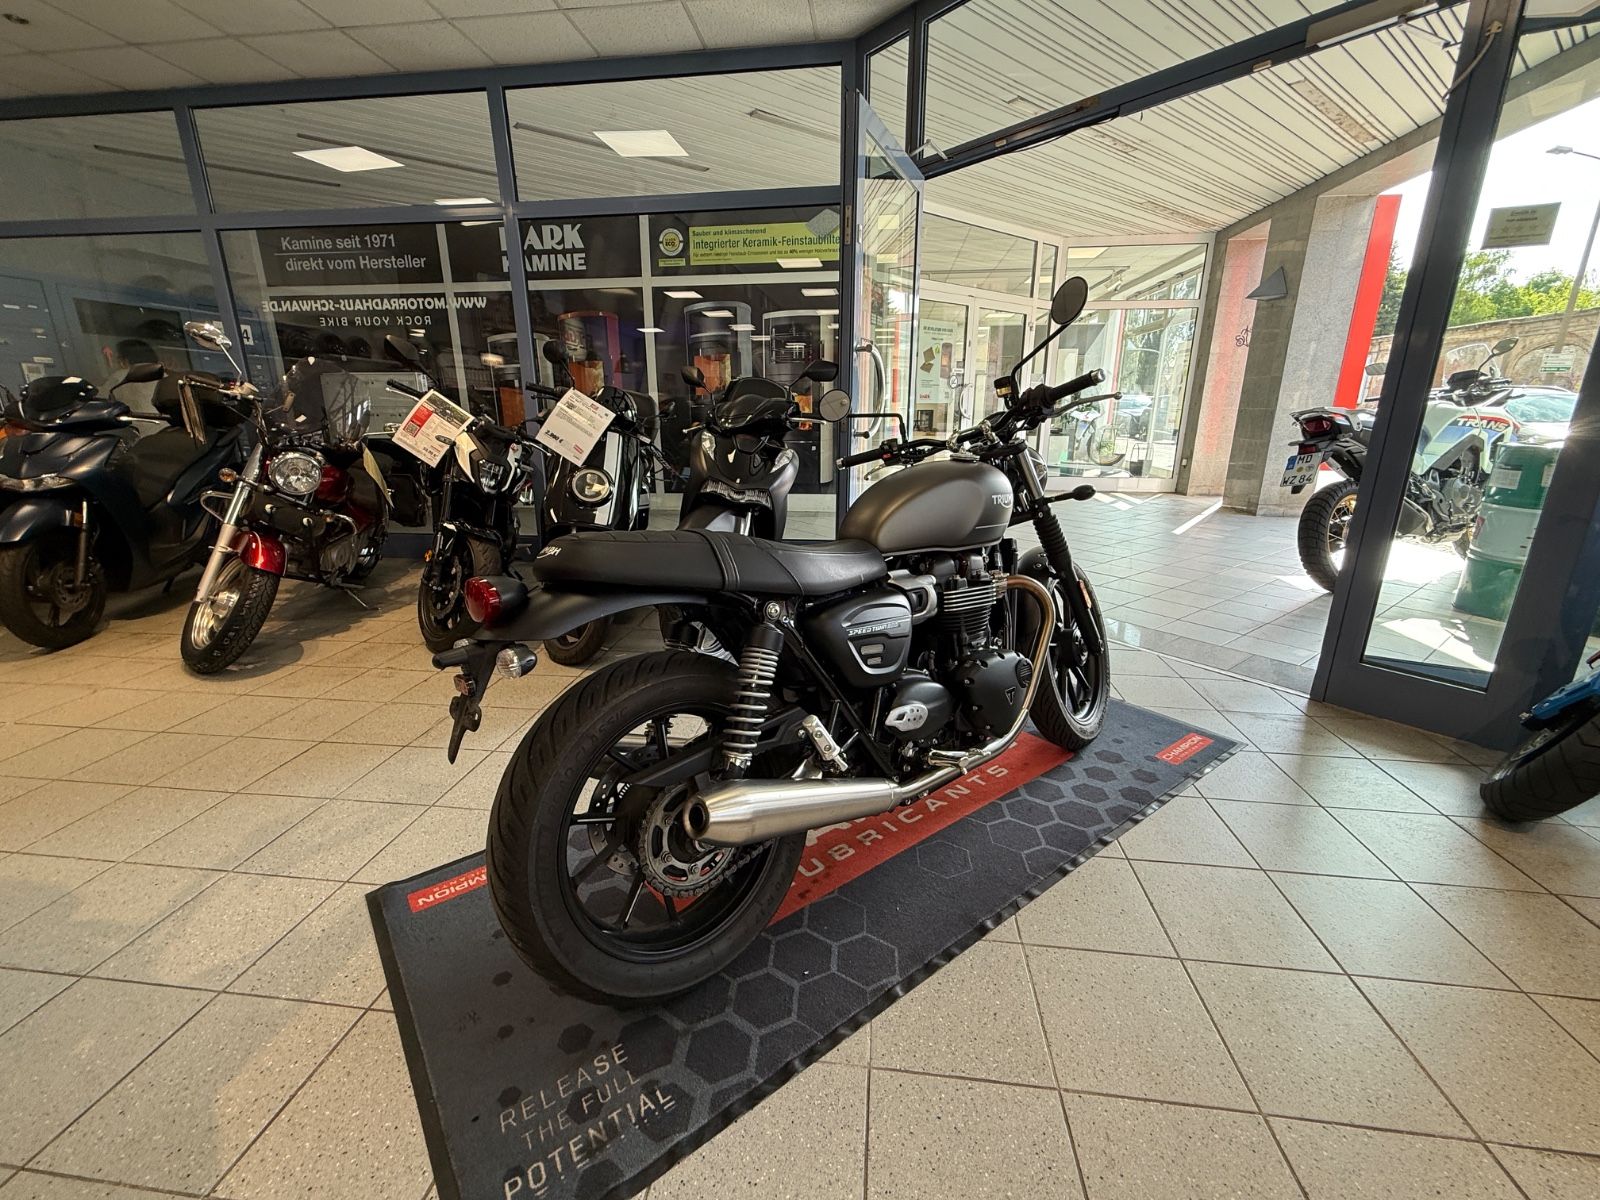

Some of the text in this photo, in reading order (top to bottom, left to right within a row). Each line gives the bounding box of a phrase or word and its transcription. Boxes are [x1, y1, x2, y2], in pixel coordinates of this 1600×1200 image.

[281, 233, 396, 250] Kamine seit 1971
[692, 234, 841, 251] Integrierter Keramik-Feinstaubfilte
[285, 254, 426, 271] direkt vom Hersteller
[1456, 417, 1508, 432] TRANS
[1297, 455, 1313, 464] MD
[1283, 473, 1313, 485] WZ 84
[791, 764, 1009, 887] UBRICANTS
[417, 874, 487, 906] MPION
[500, 1043, 629, 1134] RELEASE
[520, 1070, 641, 1151] THE FULL
[503, 1087, 676, 1200] POTENTIAL
